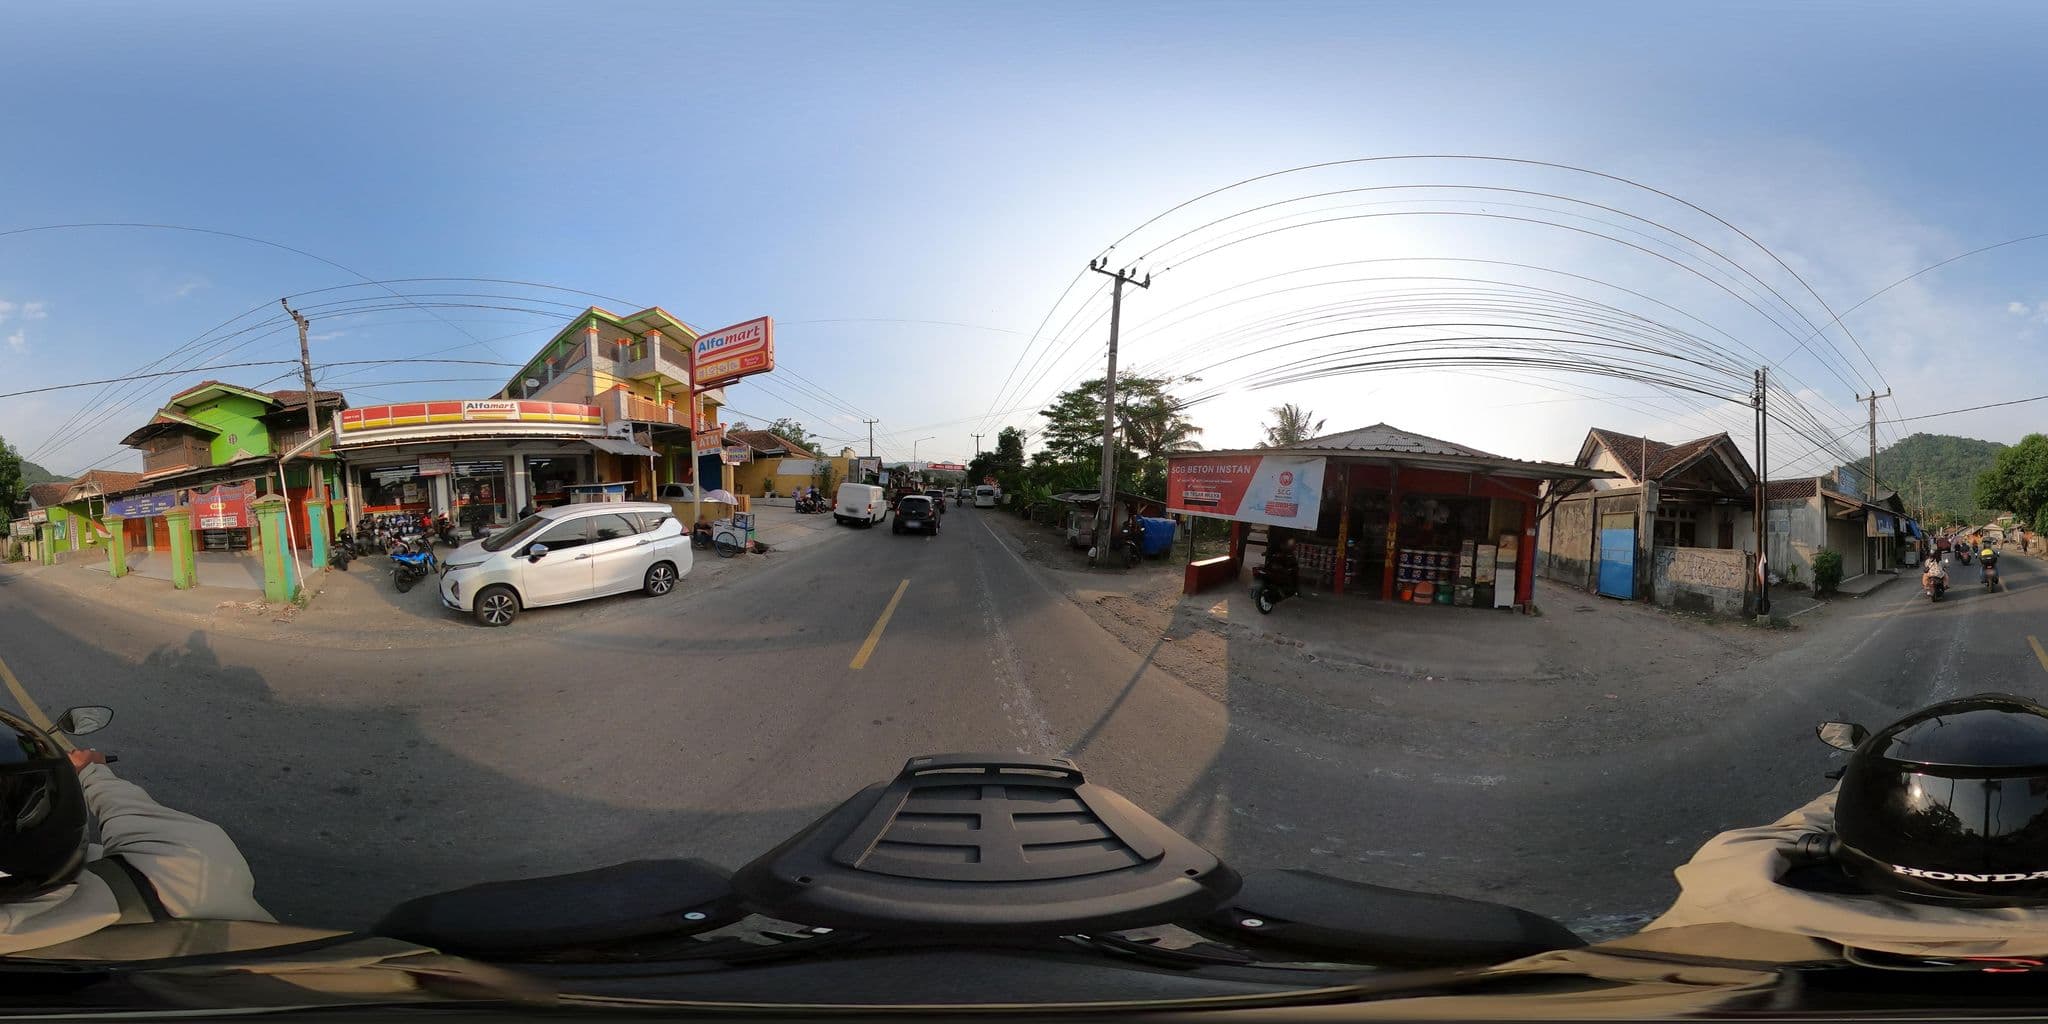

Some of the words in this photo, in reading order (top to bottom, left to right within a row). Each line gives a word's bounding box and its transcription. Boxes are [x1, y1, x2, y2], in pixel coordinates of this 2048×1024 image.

[698, 325, 760, 353] Alfamart
[466, 402, 516, 410] Alfamart
[699, 435, 719, 448] ATM
[1171, 466, 1185, 474] SCG
[1187, 465, 1215, 474] BETON
[1216, 465, 1251, 474] INSTAN
[1892, 864, 2048, 882] HONDA
